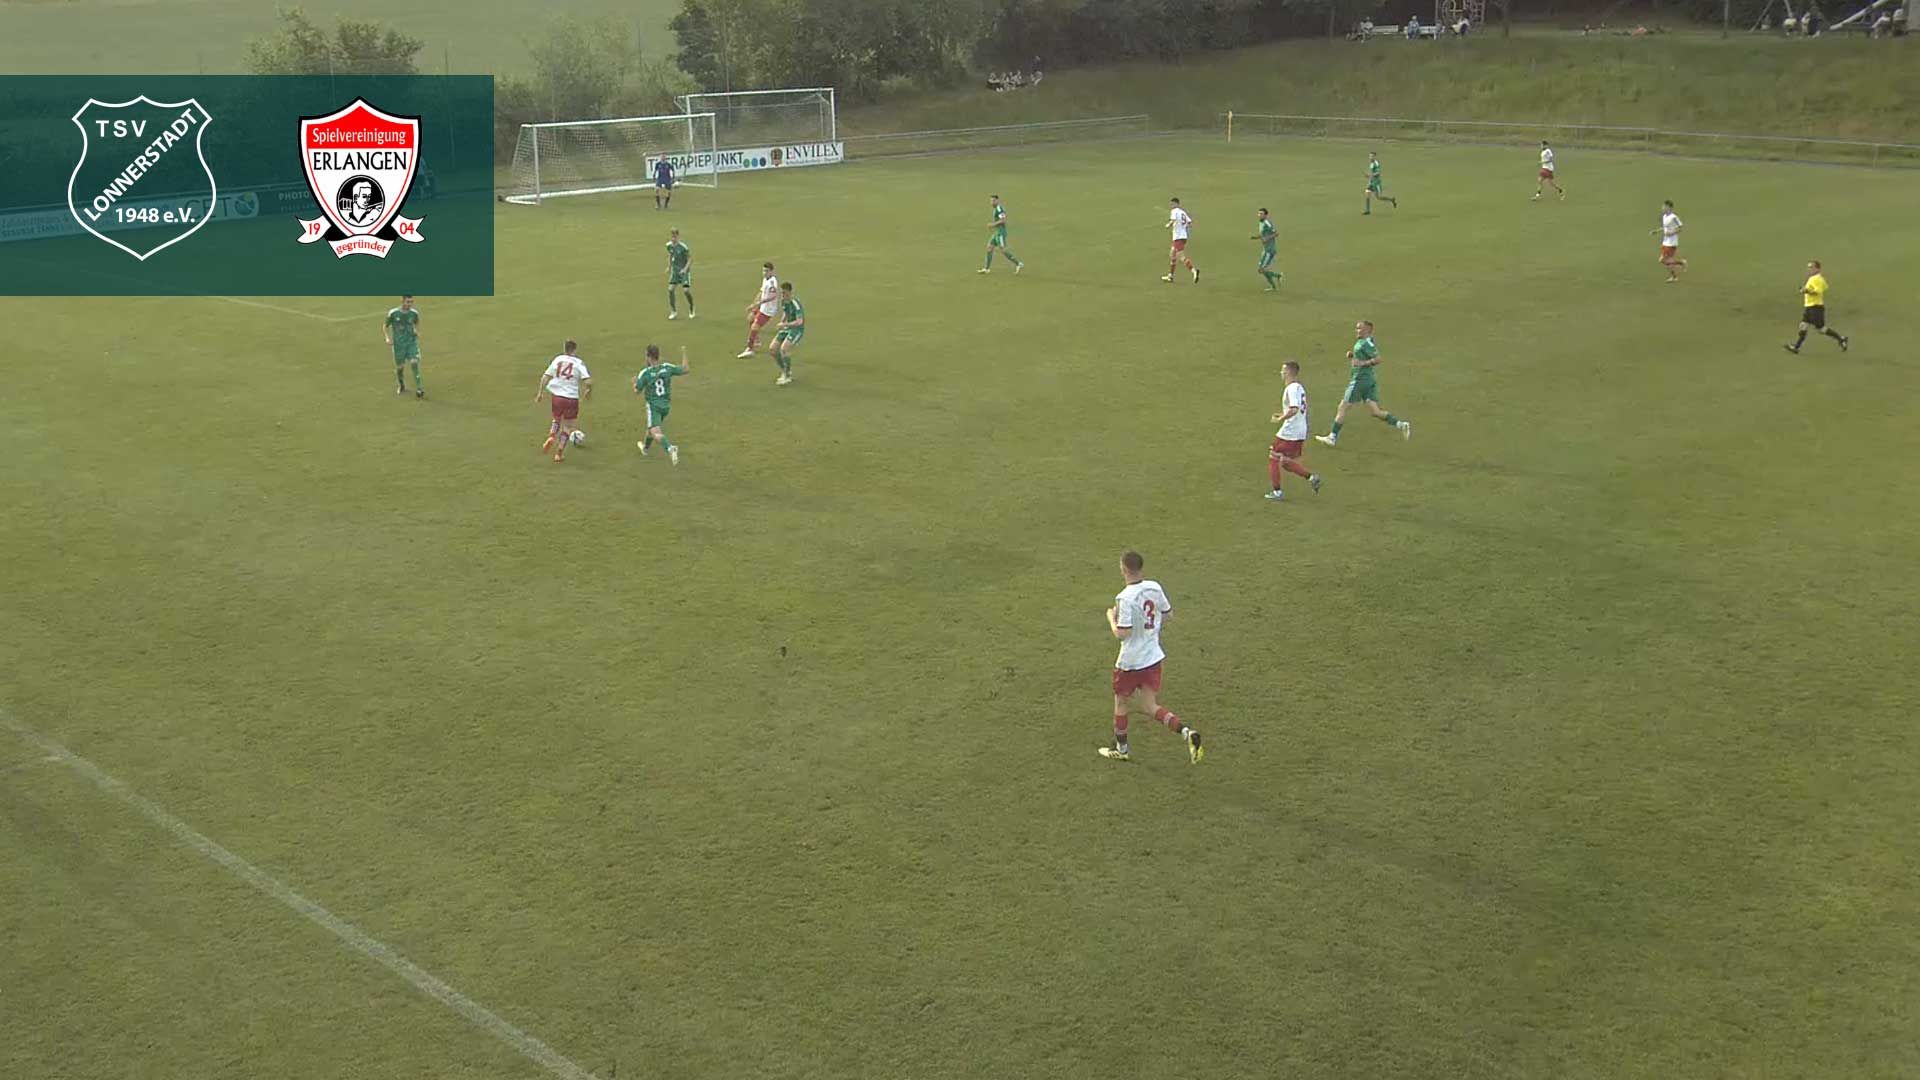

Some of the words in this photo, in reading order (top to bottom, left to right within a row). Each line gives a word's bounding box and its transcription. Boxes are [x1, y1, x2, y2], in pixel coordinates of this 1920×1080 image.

[786, 143, 839, 160] ENVILEX
[556, 361, 574, 380] 14
[655, 378, 665, 397] 8
[1143, 599, 1155, 629] 3
